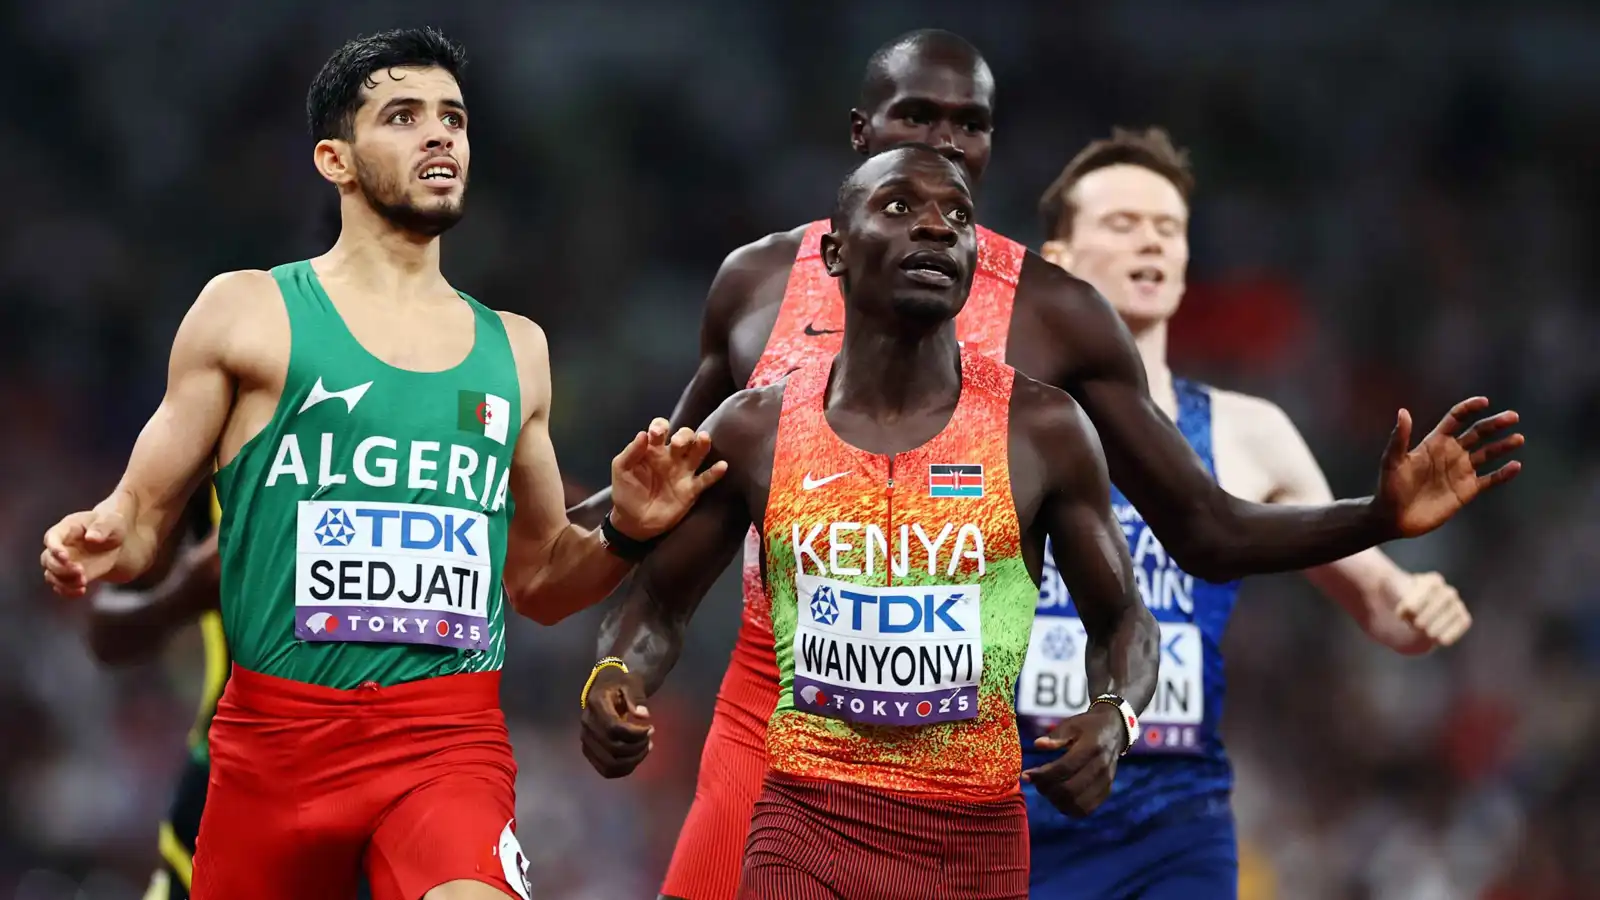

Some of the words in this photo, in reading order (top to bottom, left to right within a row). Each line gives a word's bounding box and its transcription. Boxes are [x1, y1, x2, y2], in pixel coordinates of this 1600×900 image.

[265, 433, 510, 512] ALGERIA
[356, 509, 478, 556] TDK
[792, 522, 986, 577] KENYA
[308, 560, 479, 610] SEDJATI
[840, 590, 966, 634] TDK
[802, 633, 973, 686] WANYONYI
[1035, 672, 1189, 714] BUIN
